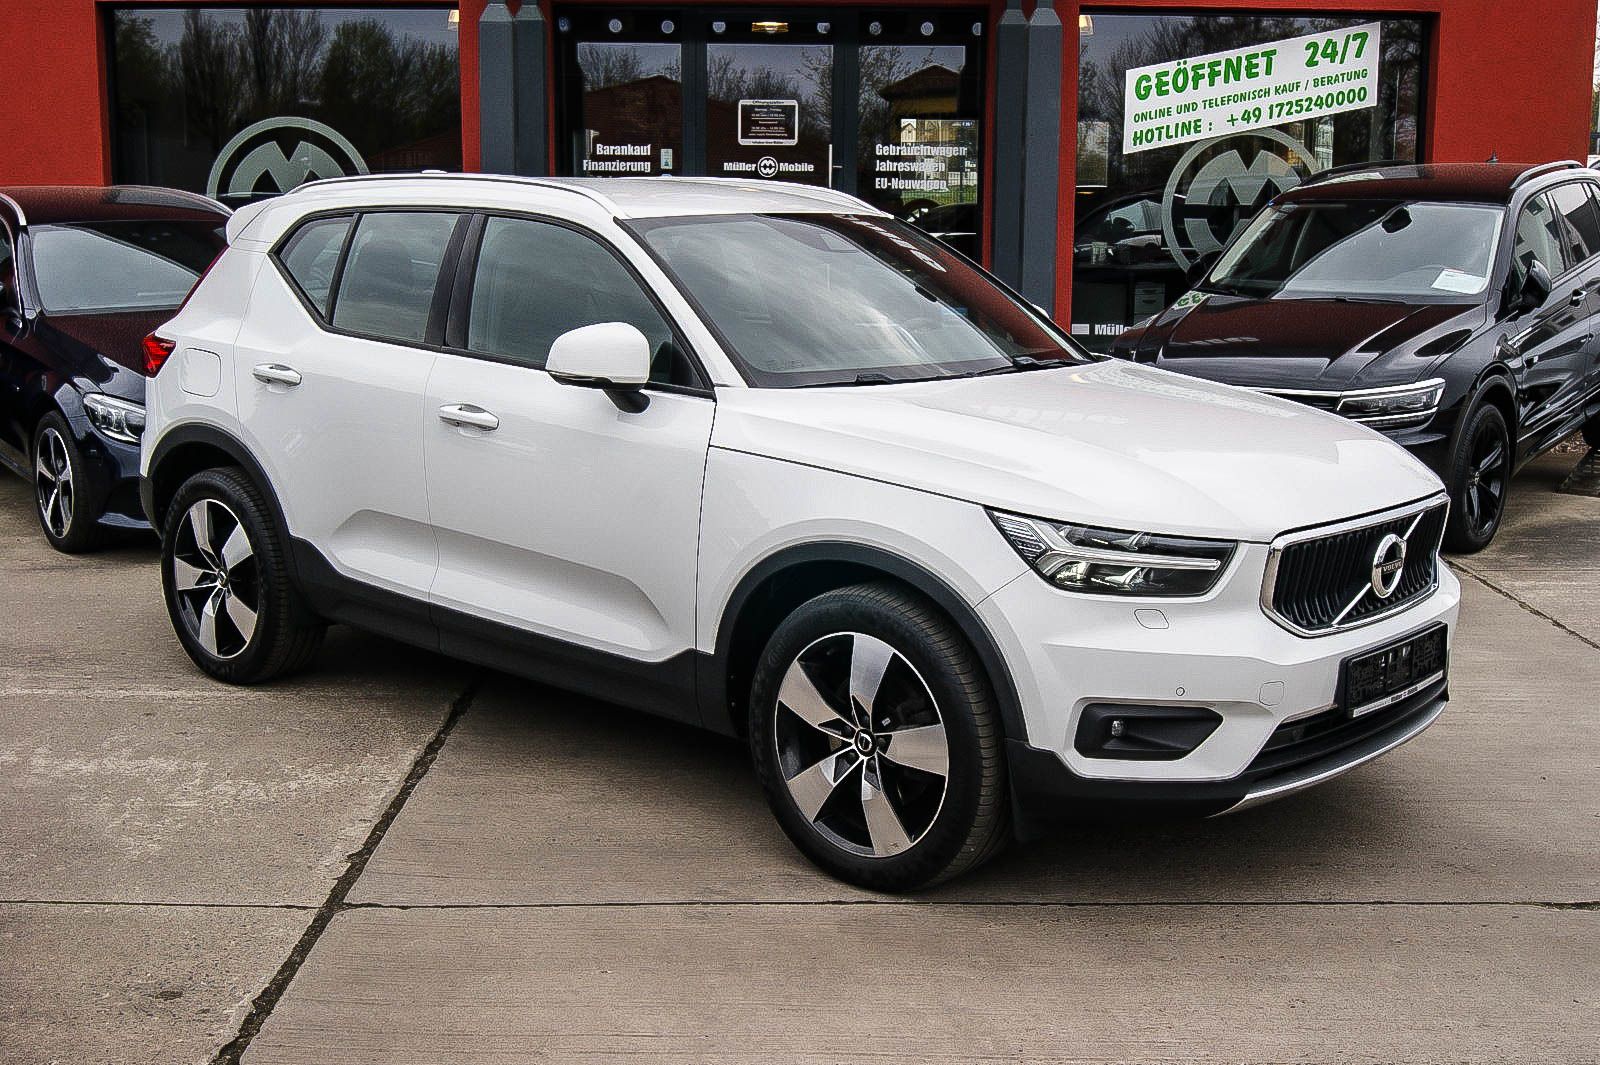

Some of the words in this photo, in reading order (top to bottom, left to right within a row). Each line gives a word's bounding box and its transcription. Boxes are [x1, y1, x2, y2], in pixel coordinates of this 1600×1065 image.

[1135, 49, 1277, 100] GEÖFFNET
[1305, 32, 1369, 68] 24/7
[1133, 106, 1172, 123] ONLINE
[1176, 101, 1198, 115] UND
[1202, 87, 1271, 109] TELEFONISCH
[1274, 81, 1302, 96] KAUF
[1313, 68, 1368, 88] BERATUNG
[1132, 118, 1202, 146] HOTLINE
[1226, 106, 1262, 127] +49
[1268, 86, 1368, 120] 1725240000
[596, 143, 652, 156] Barankauf
[875, 143, 968, 158] Gebrauchtwagen
[583, 159, 652, 173] Finanzierung
[723, 161, 757, 172] Müller
[779, 162, 815, 172] Mobile
